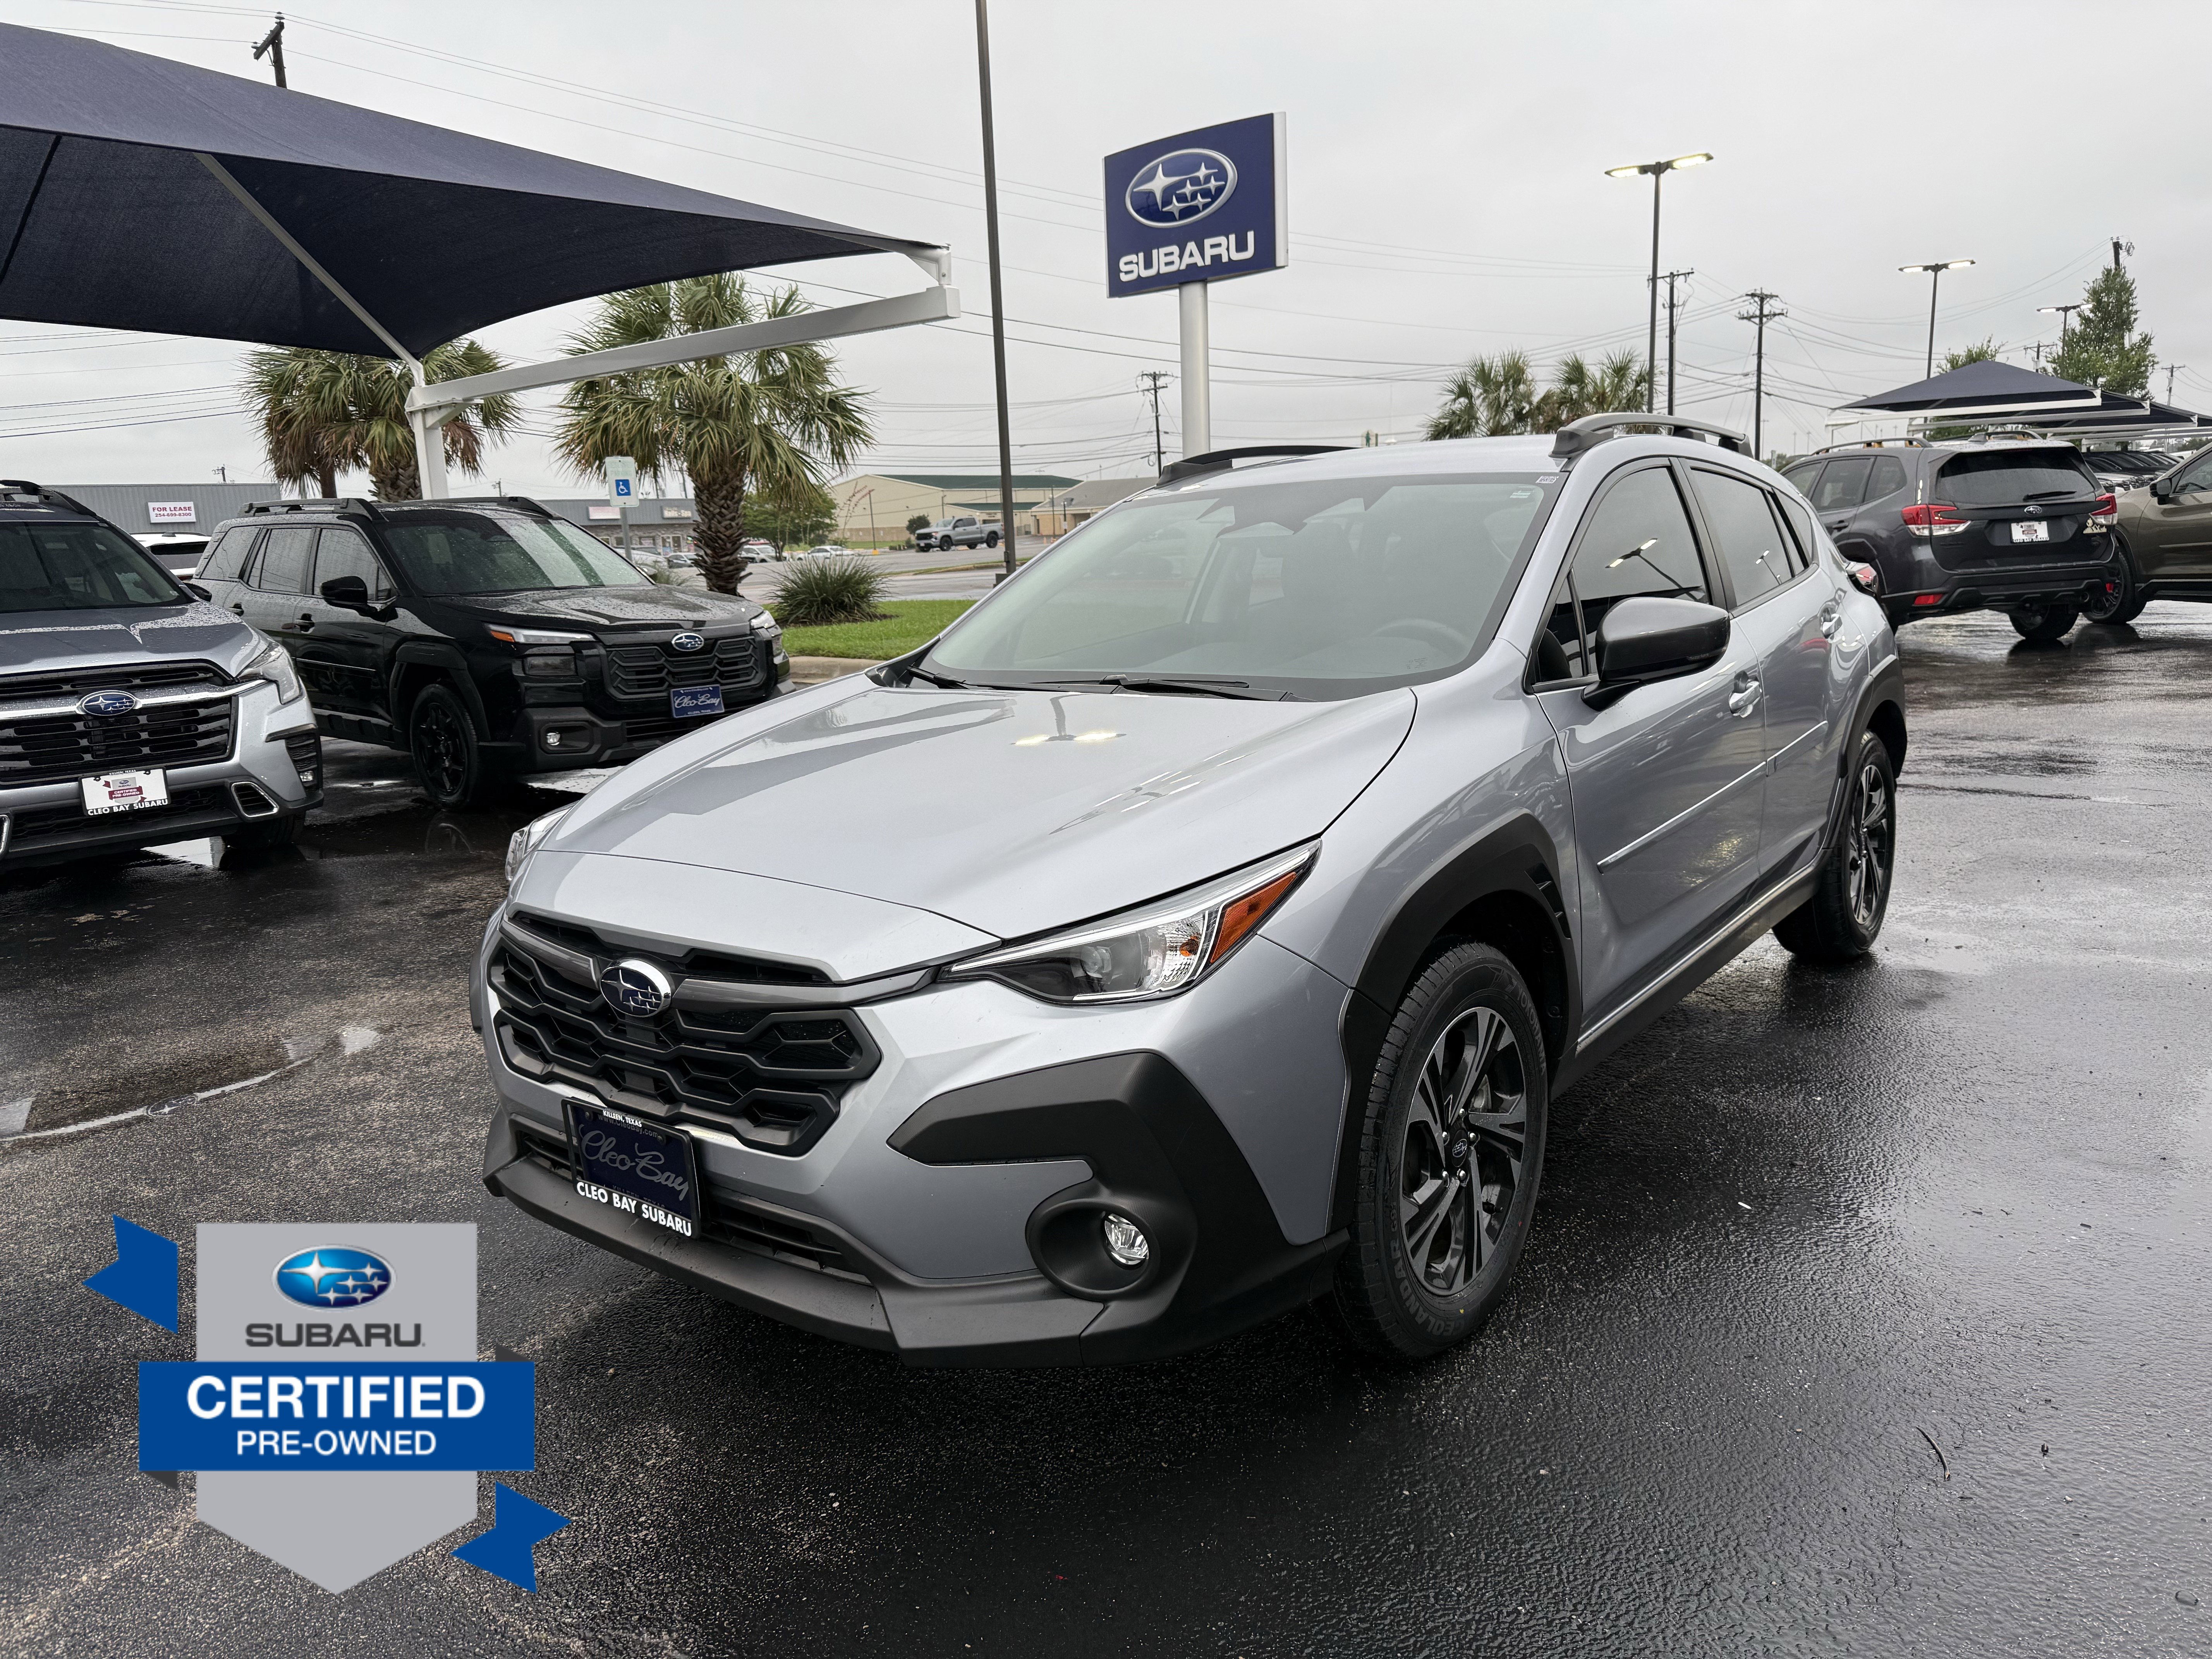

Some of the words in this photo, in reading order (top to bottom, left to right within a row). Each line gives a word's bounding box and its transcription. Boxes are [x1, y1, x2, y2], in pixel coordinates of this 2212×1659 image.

[1119, 230, 1255, 282] SUBARU
[88, 807, 110, 816] CLEO
[113, 804, 130, 812] BAY
[134, 799, 168, 809] SUBARU
[1517, 985, 1546, 1075] YOKOHAMA
[603, 1110, 625, 1123] KILLEEN,
[625, 1117, 642, 1127] TEXAS
[579, 1124, 636, 1170] Cleo
[635, 1143, 689, 1200] Bay
[577, 1182, 608, 1203] CLEO
[613, 1193, 637, 1213] BAY
[641, 1204, 692, 1237] SUBARU
